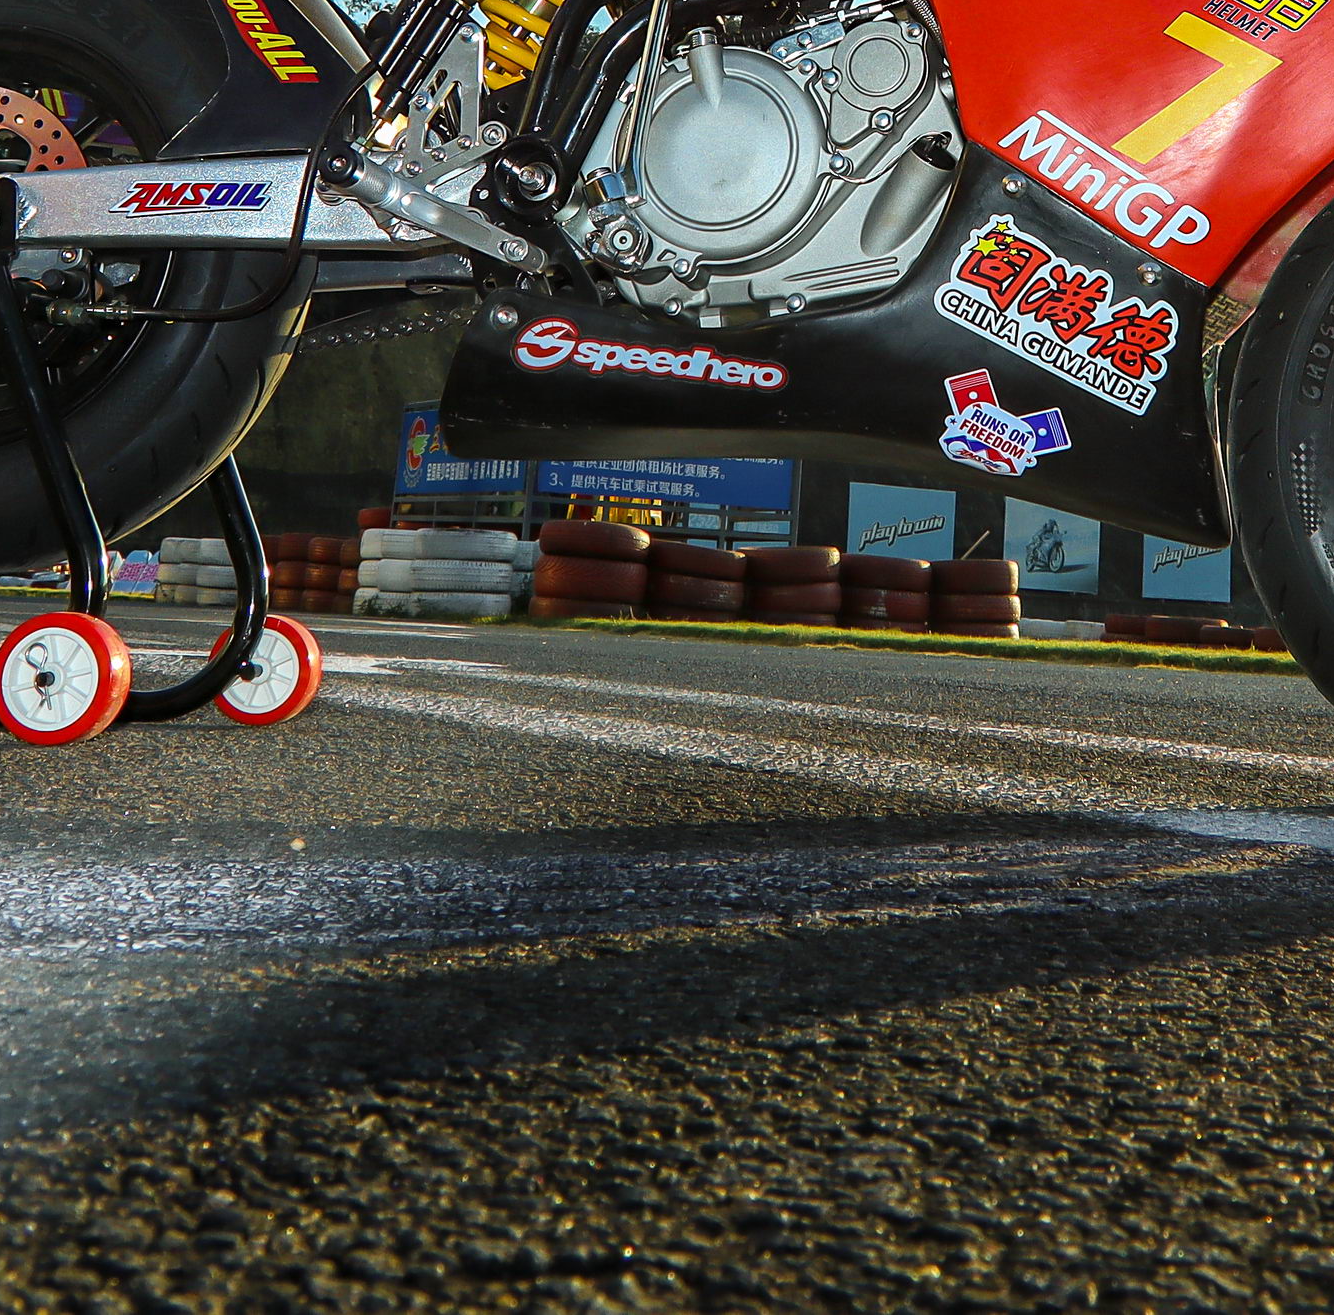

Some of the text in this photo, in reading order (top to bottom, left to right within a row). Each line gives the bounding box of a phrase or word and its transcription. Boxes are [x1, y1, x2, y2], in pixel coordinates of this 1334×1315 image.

[1111, 11, 1284, 165] 7
[118, 181, 270, 213] AMSOIL
[997, 110, 1211, 249] MiniGP
[573, 341, 784, 387] speedhero
[941, 289, 1153, 412] CHINA GUMANDE
[958, 418, 1026, 461] FREEDOM
[970, 408, 1030, 448] RUNS ON
[859, 521, 897, 552] play
